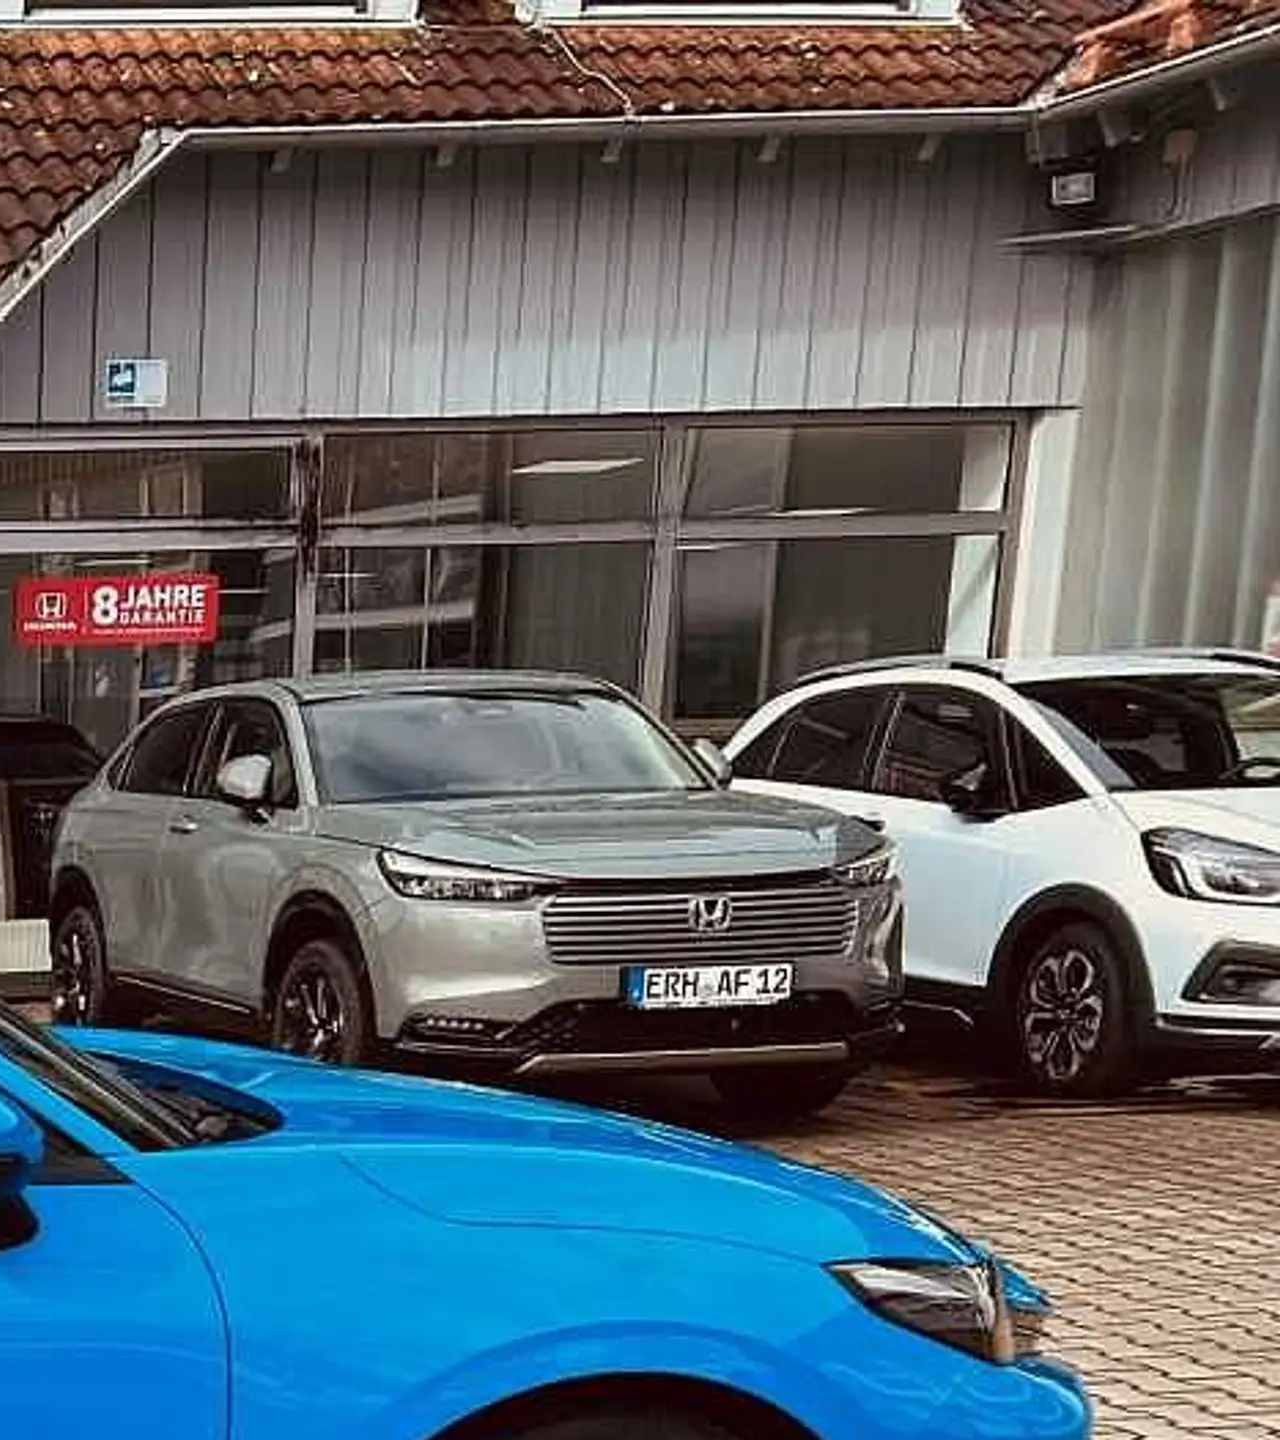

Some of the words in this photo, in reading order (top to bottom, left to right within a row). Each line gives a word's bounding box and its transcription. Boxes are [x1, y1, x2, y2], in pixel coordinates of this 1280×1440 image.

[91, 585, 119, 626] 8
[120, 583, 205, 609] JAHRE
[645, 970, 700, 999] ERH
[717, 967, 753, 997] AF
[755, 967, 789, 995] 12
